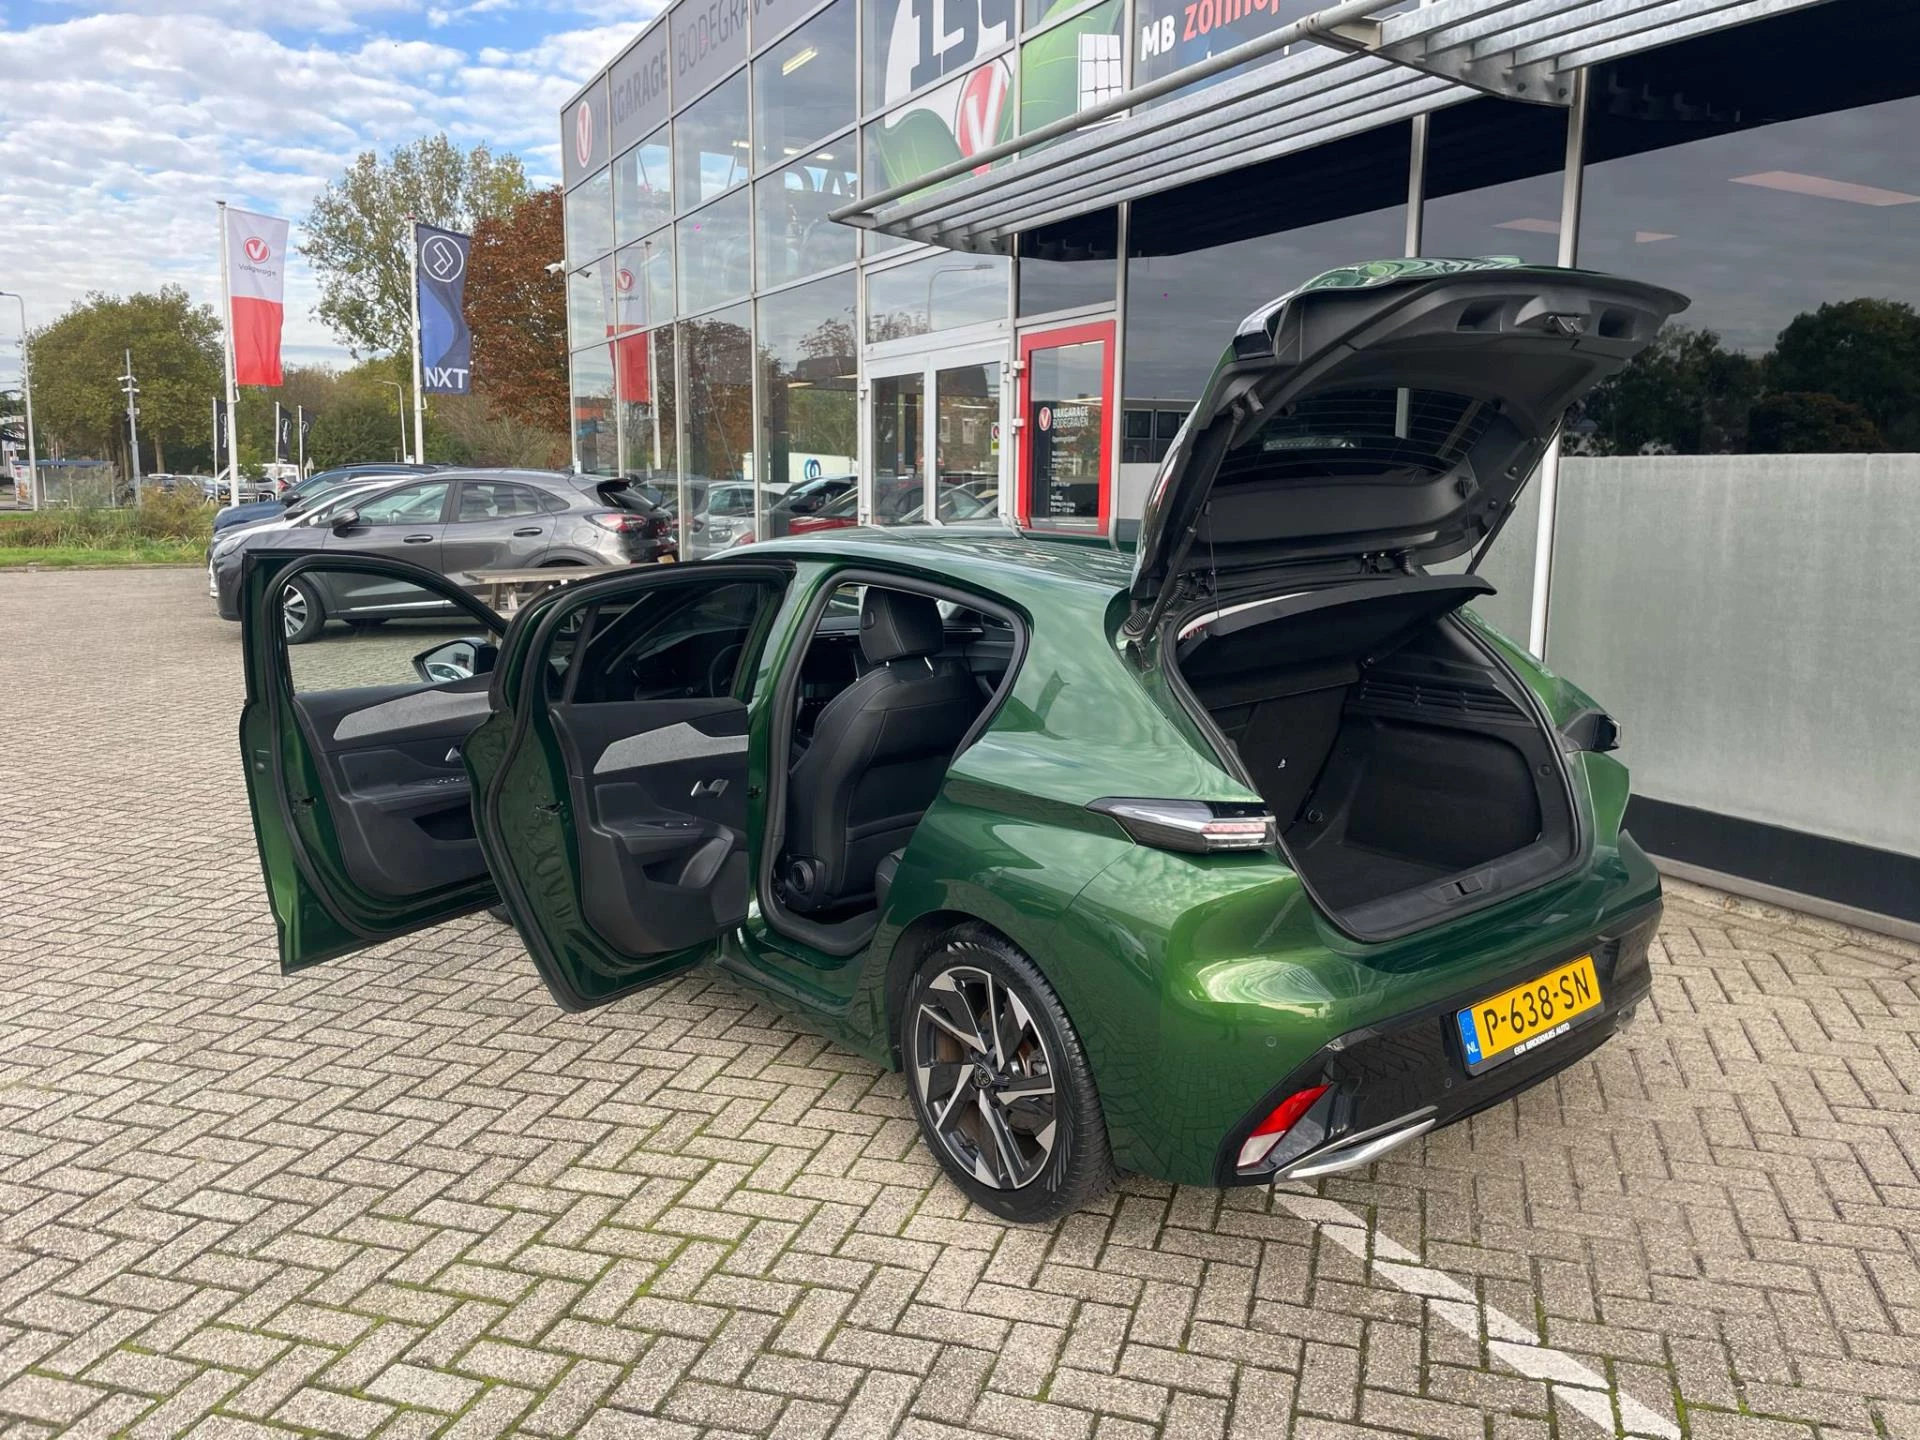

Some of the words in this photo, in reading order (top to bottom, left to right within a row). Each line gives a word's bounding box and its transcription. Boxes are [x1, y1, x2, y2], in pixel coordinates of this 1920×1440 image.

[1140, 14, 1176, 62] MB
[1183, 0, 1281, 42] zonn
[595, 49, 668, 140] VGARAGE
[678, 0, 774, 77] BODEGR
[425, 366, 469, 388] NXT
[1052, 405, 1088, 418] VAKGARAGE
[1052, 416, 1089, 429] BODEGRAVEN
[1483, 967, 1591, 1047] P-638-SN
[1556, 1022, 1570, 1035] AUTO
[1466, 1041, 1479, 1056] NL
